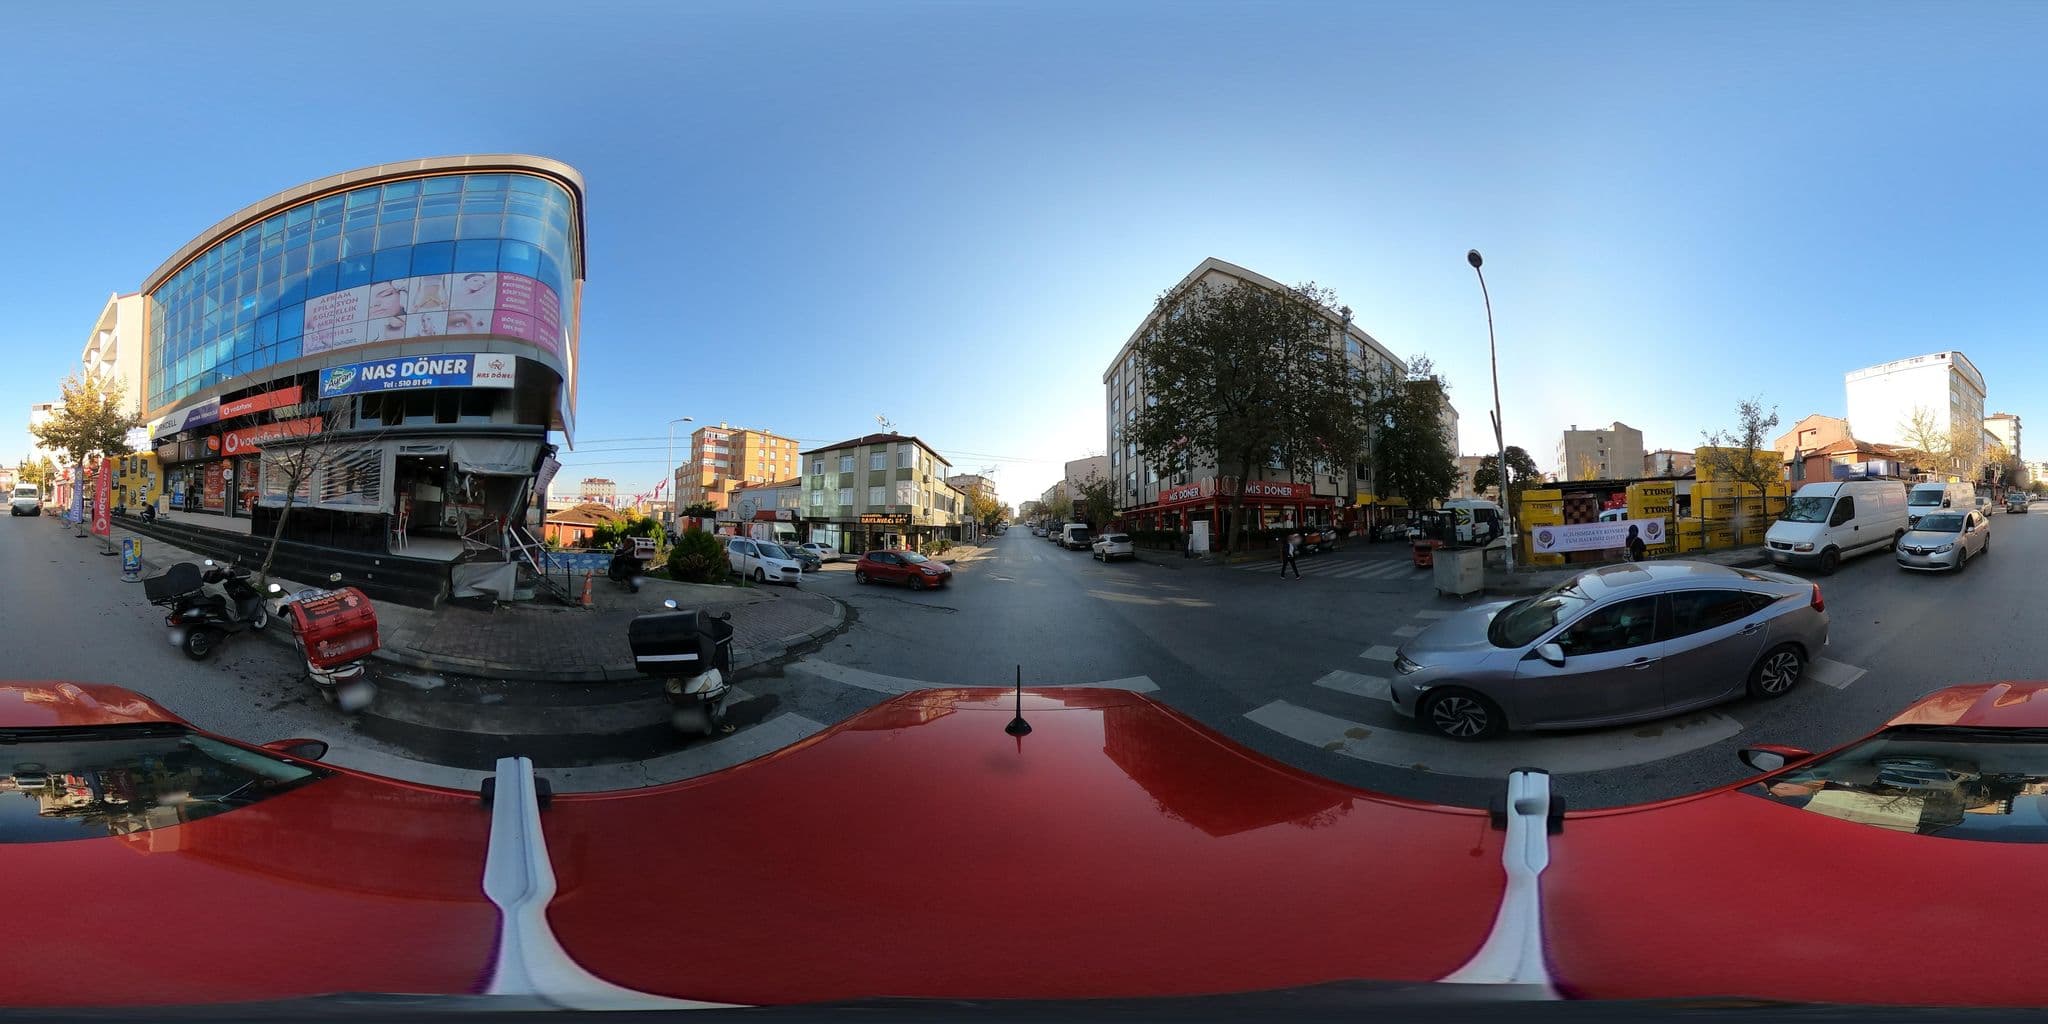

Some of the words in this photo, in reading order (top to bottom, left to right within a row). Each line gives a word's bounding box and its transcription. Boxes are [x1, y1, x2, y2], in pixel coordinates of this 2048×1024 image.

[361, 366, 397, 381] NAS
[401, 357, 467, 377] DÖNER
[398, 379, 411, 387] 510
[230, 402, 253, 413] vodafone
[1179, 486, 1199, 500] DÖNER
[1245, 481, 1261, 494] MİS
[1264, 482, 1292, 496] DÖNER
[1643, 488, 1673, 496] YTONG
[1644, 506, 1673, 514] YTONG
